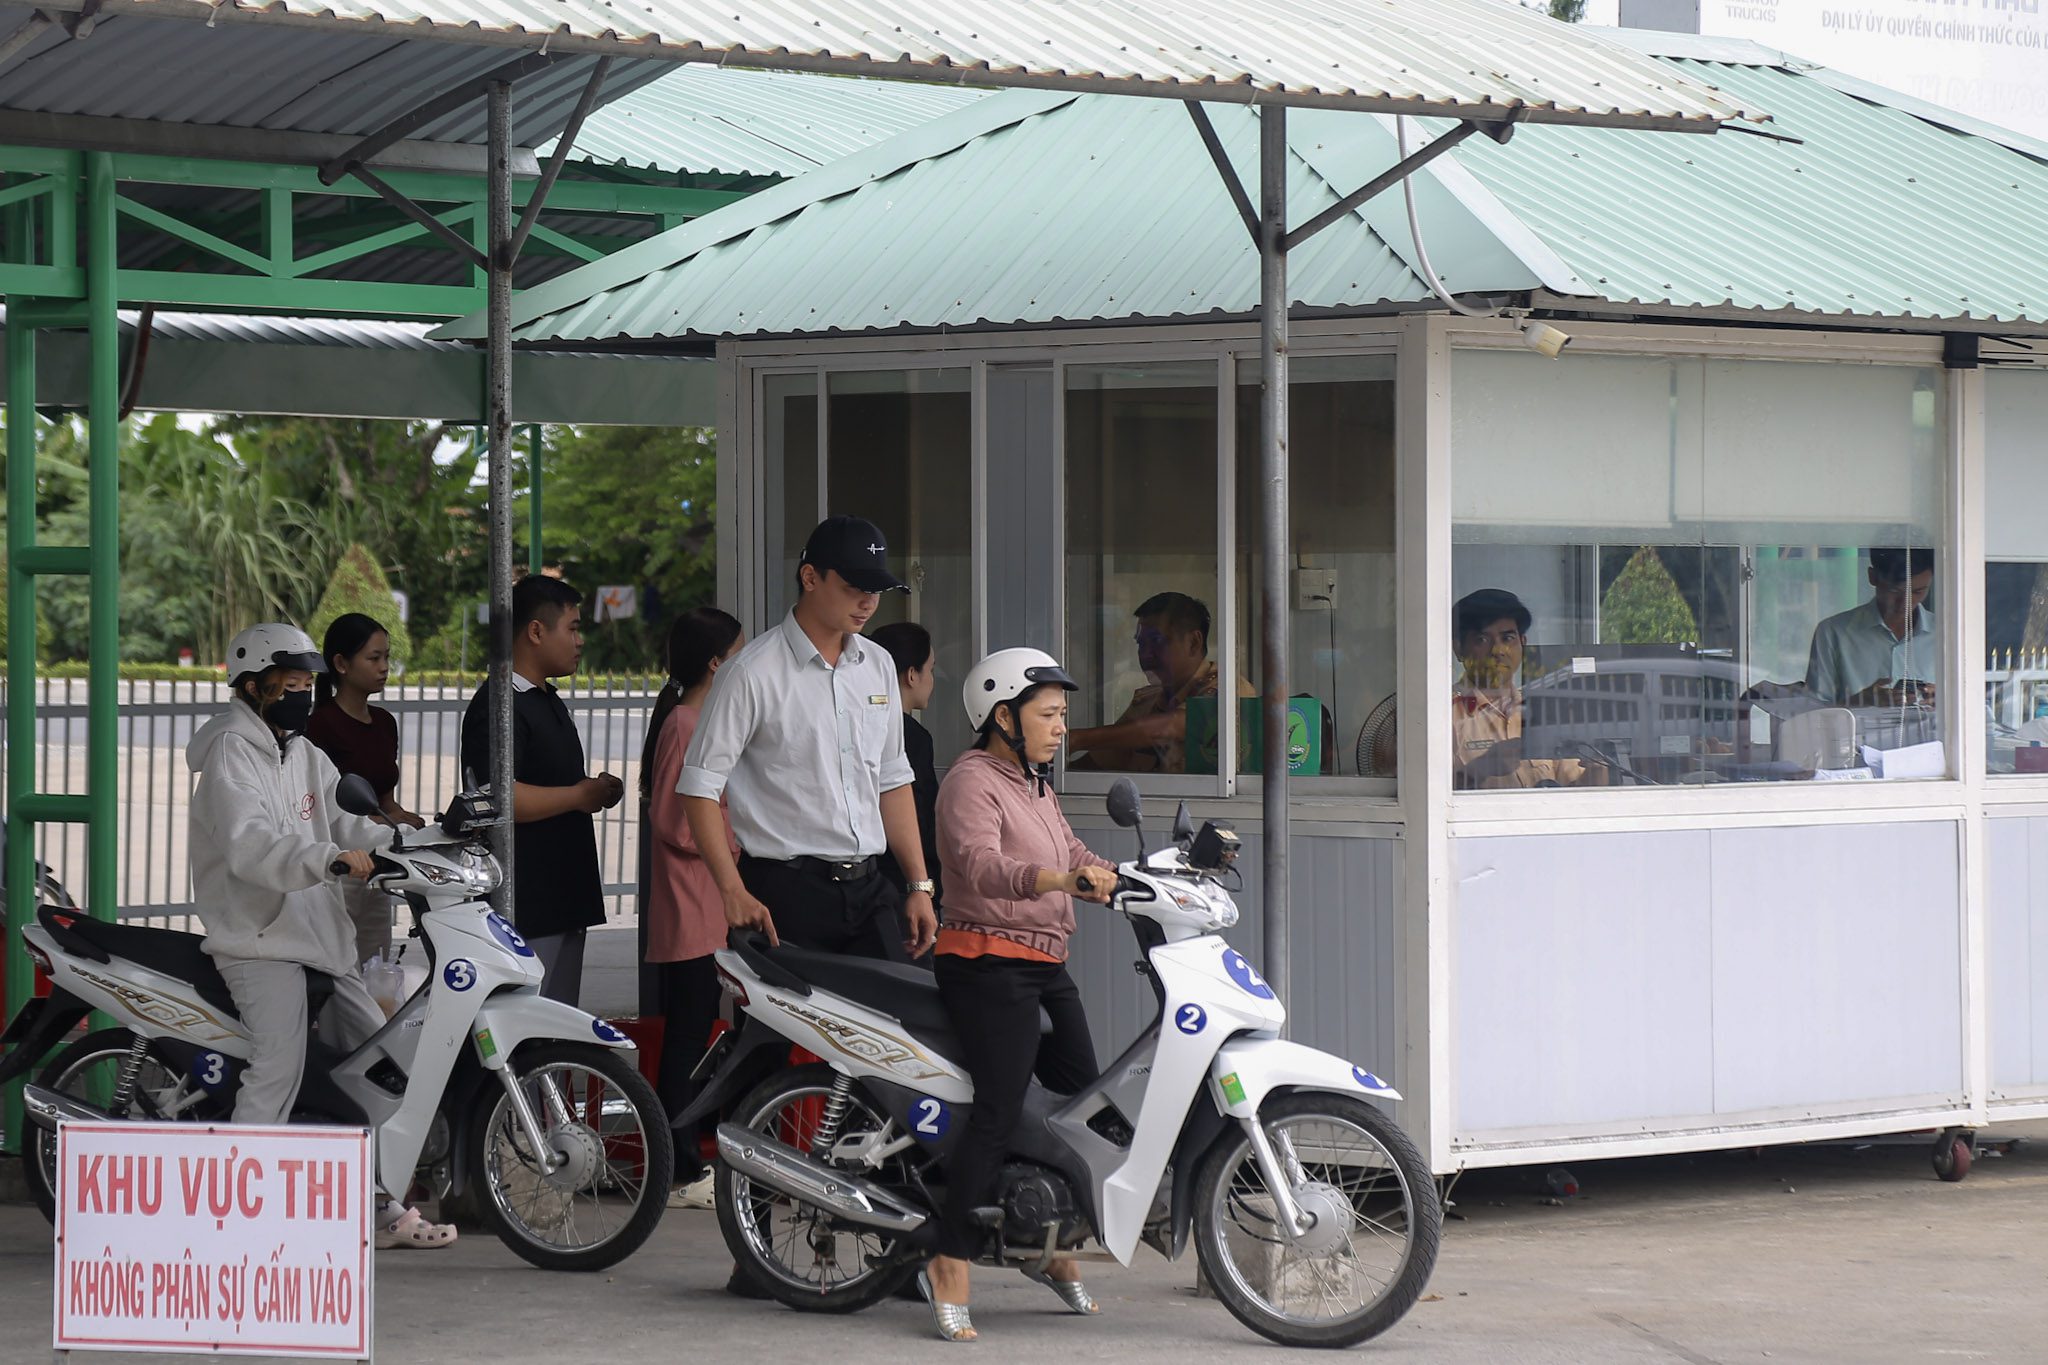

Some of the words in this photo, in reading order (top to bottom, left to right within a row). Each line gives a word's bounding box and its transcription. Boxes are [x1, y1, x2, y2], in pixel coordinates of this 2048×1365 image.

[1724, 5, 1776, 23] TRUCKS
[1821, 9, 1845, 34] ĐẠI
[1848, 9, 1863, 31] LÝ
[1866, 9, 1884, 33] ỦY
[1934, 19, 1975, 42] CHÍNH
[1977, 23, 2013, 46] THỨC
[2015, 25, 2041, 49] CỦA
[451, 961, 471, 989] 3
[405, 1018, 425, 1029] HON
[1180, 1006, 1200, 1032] 2
[201, 1053, 225, 1085] 3
[1129, 1063, 1153, 1076] HON
[916, 1098, 942, 1135] 2
[76, 1154, 163, 1217] KHU
[178, 1145, 264, 1231] VỰC
[277, 1159, 348, 1221] THI
[70, 1245, 145, 1319] KHÔNG
[151, 1247, 211, 1333] PHẬN
[216, 1254, 248, 1334] SỰ
[253, 1243, 302, 1325] CẤM
[308, 1252, 352, 1327] VÀO
